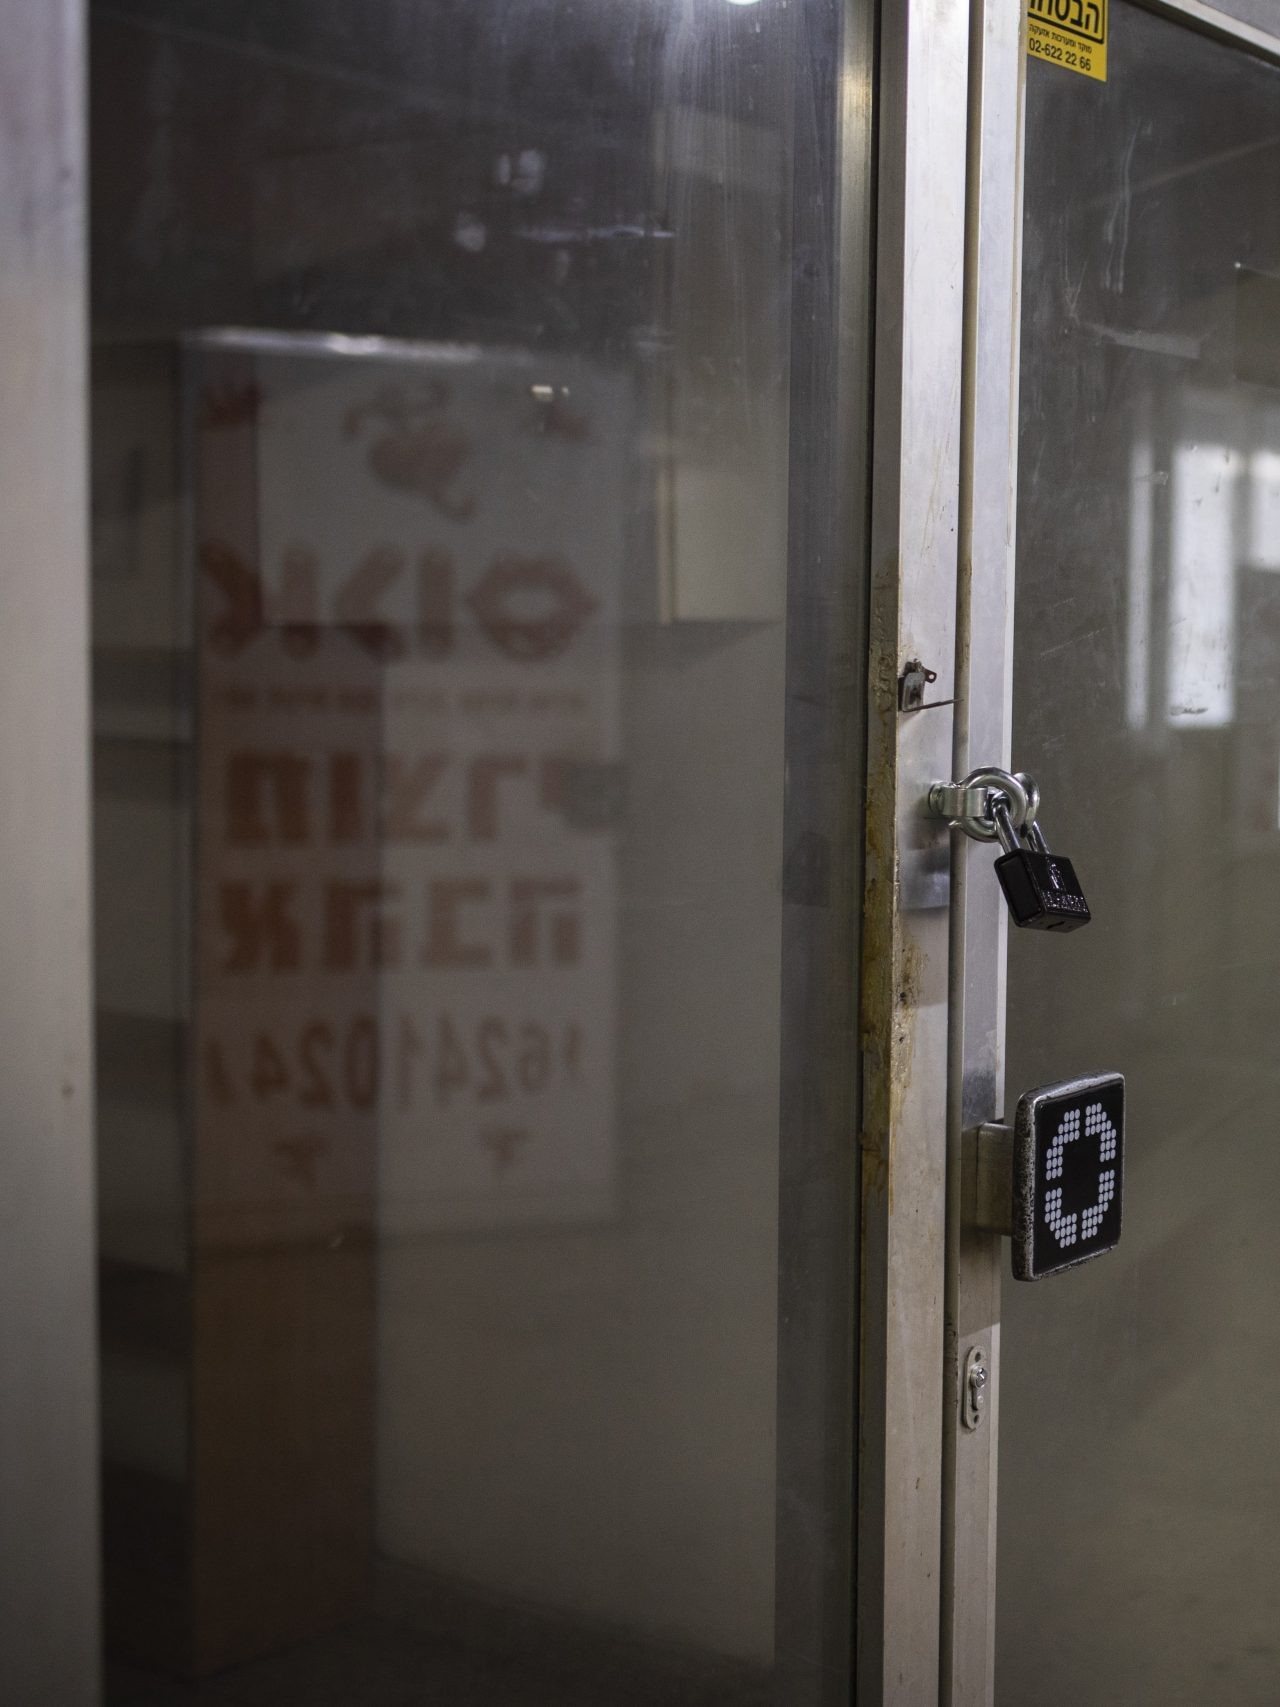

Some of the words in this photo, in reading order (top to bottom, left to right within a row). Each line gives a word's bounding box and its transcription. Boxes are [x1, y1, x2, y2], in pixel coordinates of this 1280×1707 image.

[1030, 0, 1100, 34] הבט
[1028, 37, 1063, 61] 02-622
[1065, 51, 1077, 66] 22
[1079, 56, 1092, 72] 66
